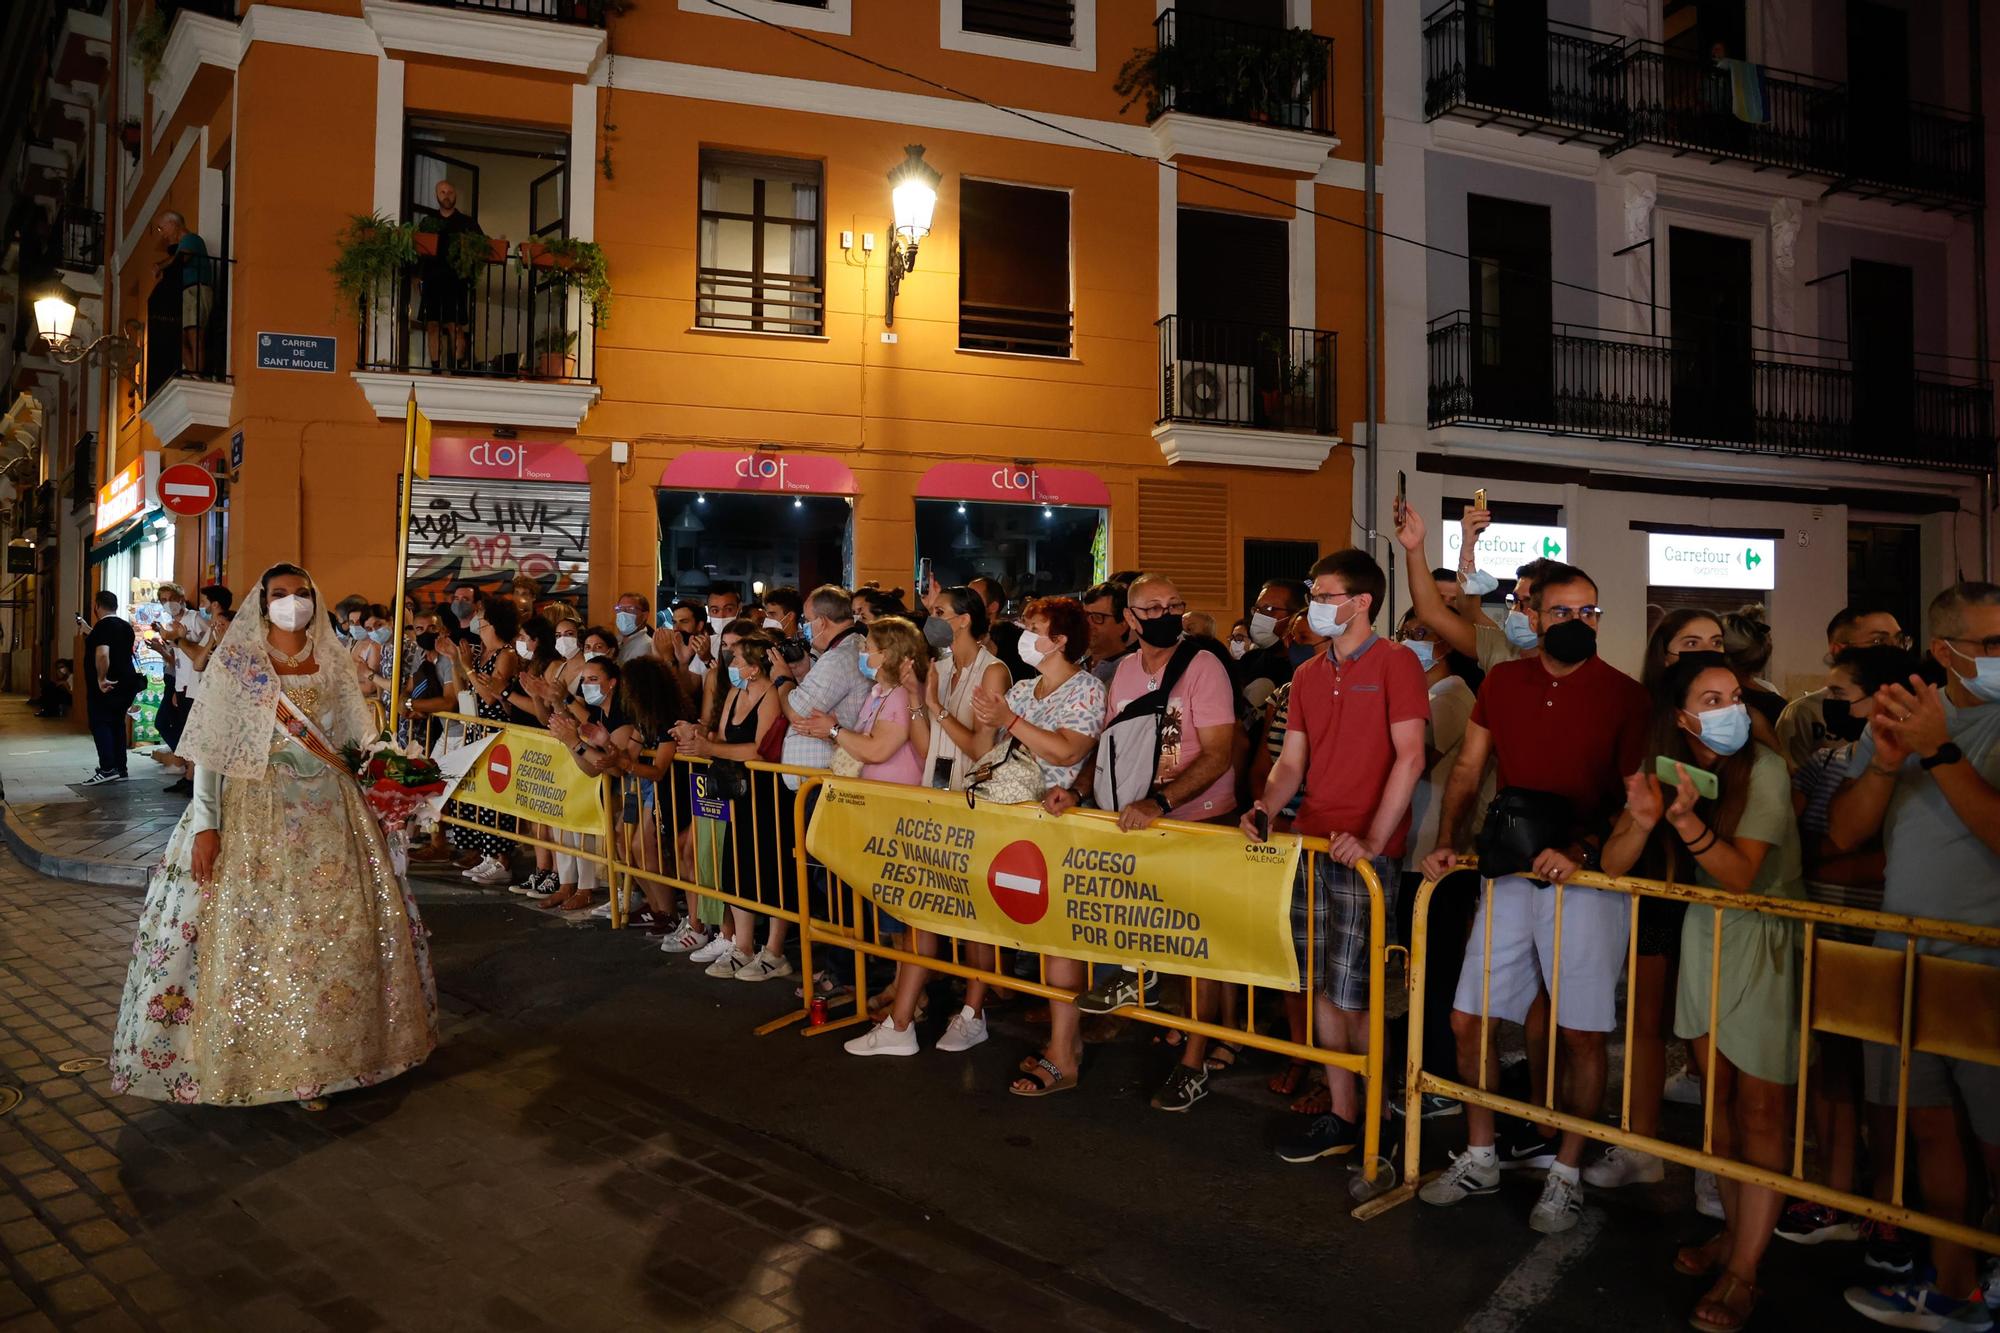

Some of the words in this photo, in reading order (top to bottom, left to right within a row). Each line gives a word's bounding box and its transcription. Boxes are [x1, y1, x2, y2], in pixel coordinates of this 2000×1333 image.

[282, 338, 318, 348] CARRER
[264, 357, 290, 366] SANT
[292, 359, 329, 369] MIQUEL
[1449, 533, 1526, 553] Crefour
[1799, 530, 1810, 547] 3
[1664, 545, 1731, 564] Carrefour
[1694, 566, 1729, 576] express
[520, 749, 552, 766] ACCESO
[516, 764, 556, 784] PEATONAL
[516, 779, 567, 802] RESTRINGIDO
[516, 794, 529, 809] POR
[530, 799, 564, 818] OFRENDA
[895, 817, 942, 843] ACCÉS
[945, 826, 975, 850] PER
[863, 836, 898, 858] ALS
[902, 841, 970, 874] VIANANTS
[1062, 847, 1136, 876] ACCESO
[880, 862, 970, 896] RESTRINGIT
[1063, 873, 1164, 902] PEATONAL
[872, 883, 904, 906] PER
[908, 890, 977, 920] OFRENA
[1066, 899, 1200, 931] RESTRINGIDO
[1072, 923, 1108, 947] POR
[1114, 930, 1209, 960] OFRENDA
